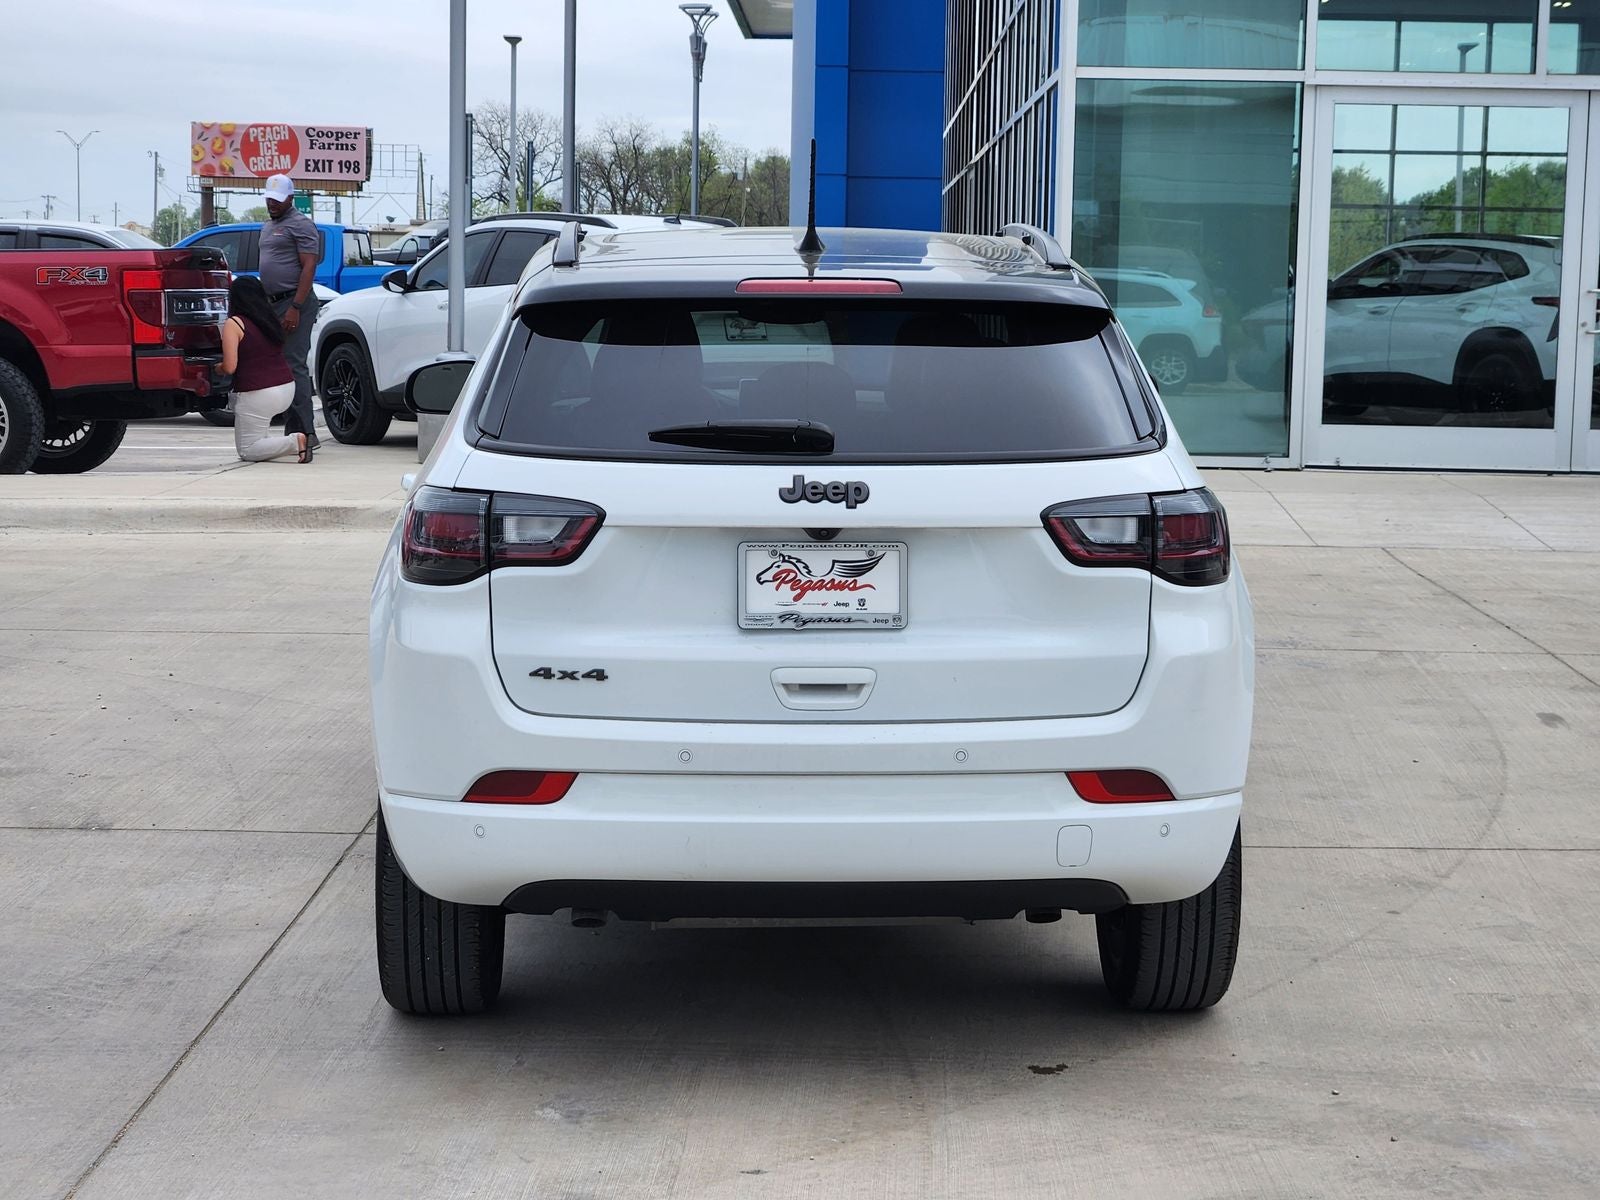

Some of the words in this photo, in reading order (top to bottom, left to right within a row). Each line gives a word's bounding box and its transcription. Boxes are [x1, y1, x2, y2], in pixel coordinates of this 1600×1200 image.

[249, 125, 289, 142] PEACH
[305, 127, 361, 140] Cooper
[259, 141, 279, 156] ICE
[308, 139, 357, 151] Farms
[249, 155, 292, 172] CREAM
[304, 159, 334, 173] EXIT
[337, 160, 361, 174] 198
[36, 266, 109, 285] FX4
[778, 474, 870, 510] Jeep
[772, 568, 877, 603] Pegasus
[778, 613, 869, 629] Pegasus
[528, 666, 609, 681] 4x4
